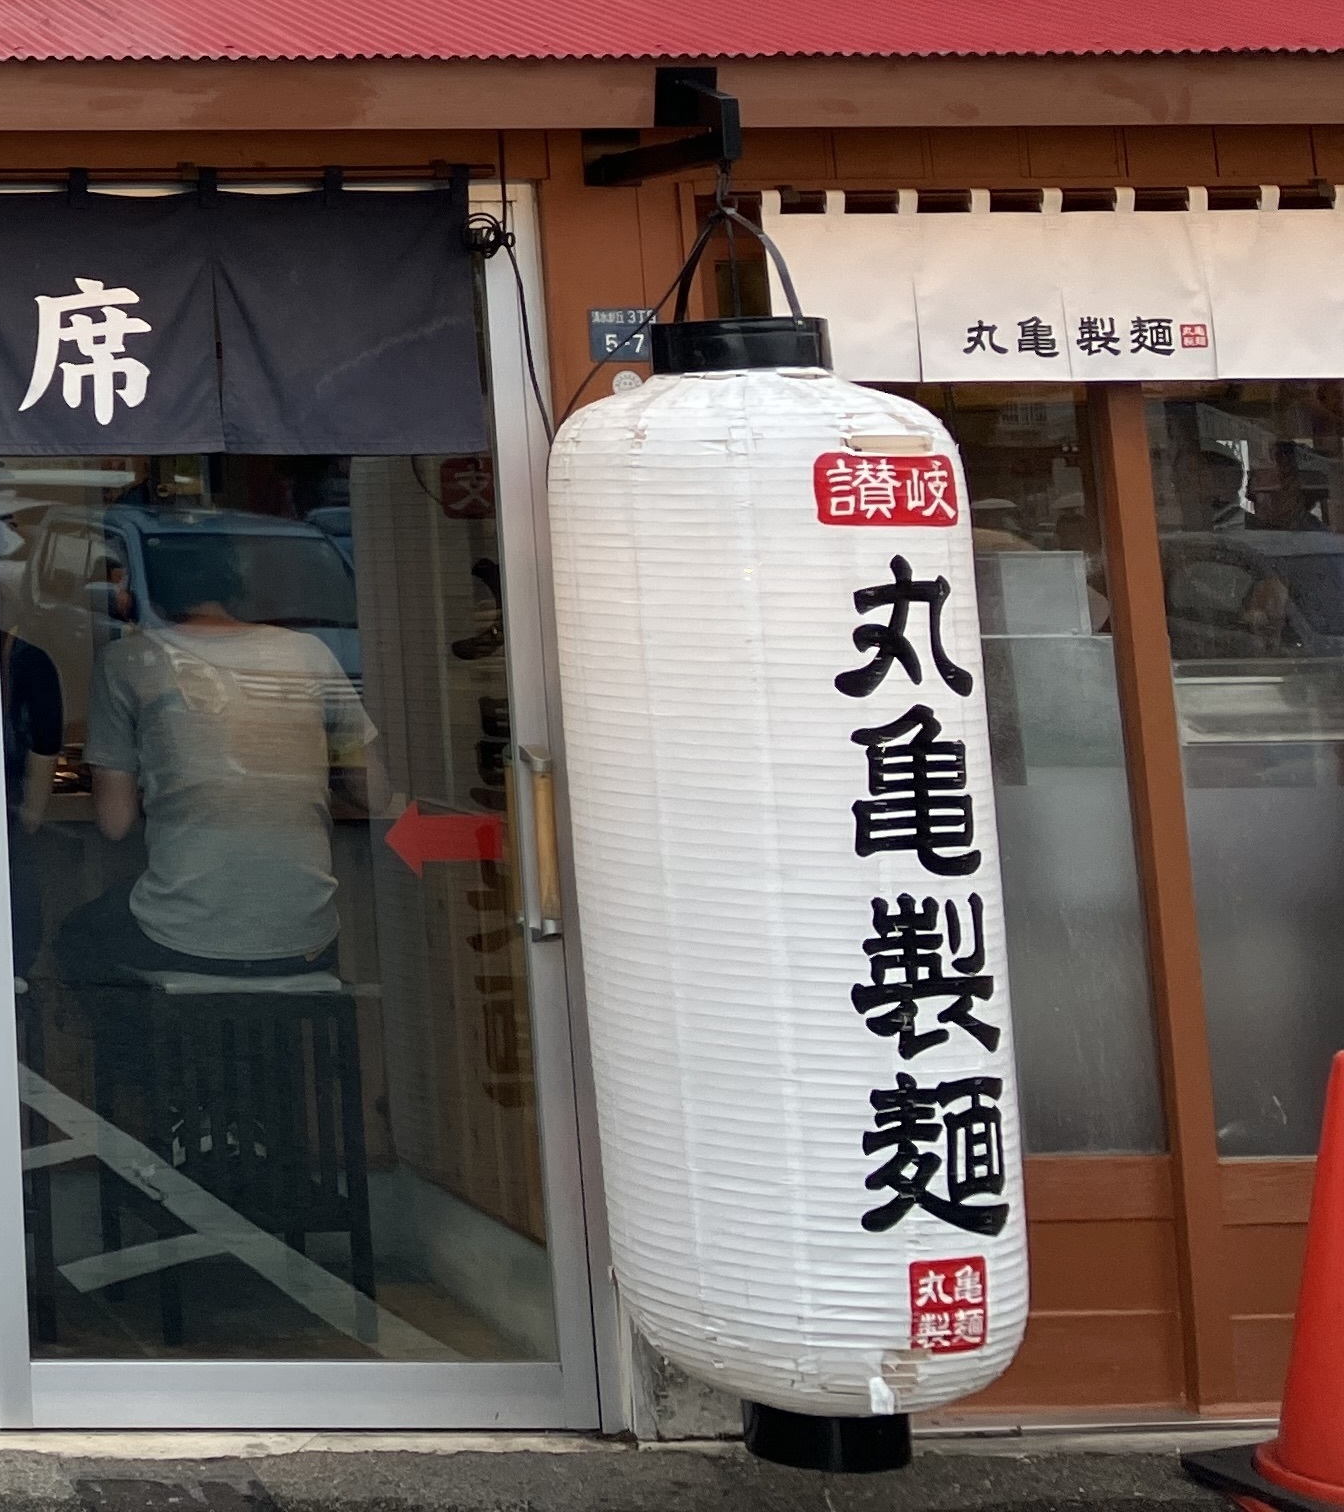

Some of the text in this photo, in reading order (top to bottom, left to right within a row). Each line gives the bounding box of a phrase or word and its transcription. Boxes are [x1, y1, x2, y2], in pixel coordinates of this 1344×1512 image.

[605, 333, 645, 353] 5-7
[963, 316, 1176, 358] 丸亀製麺
[826, 459, 957, 520] 讃岐
[834, 555, 1010, 1237] 丸亀製麺
[916, 1264, 984, 1307] 丸亀
[915, 1308, 985, 1349] 製麺
